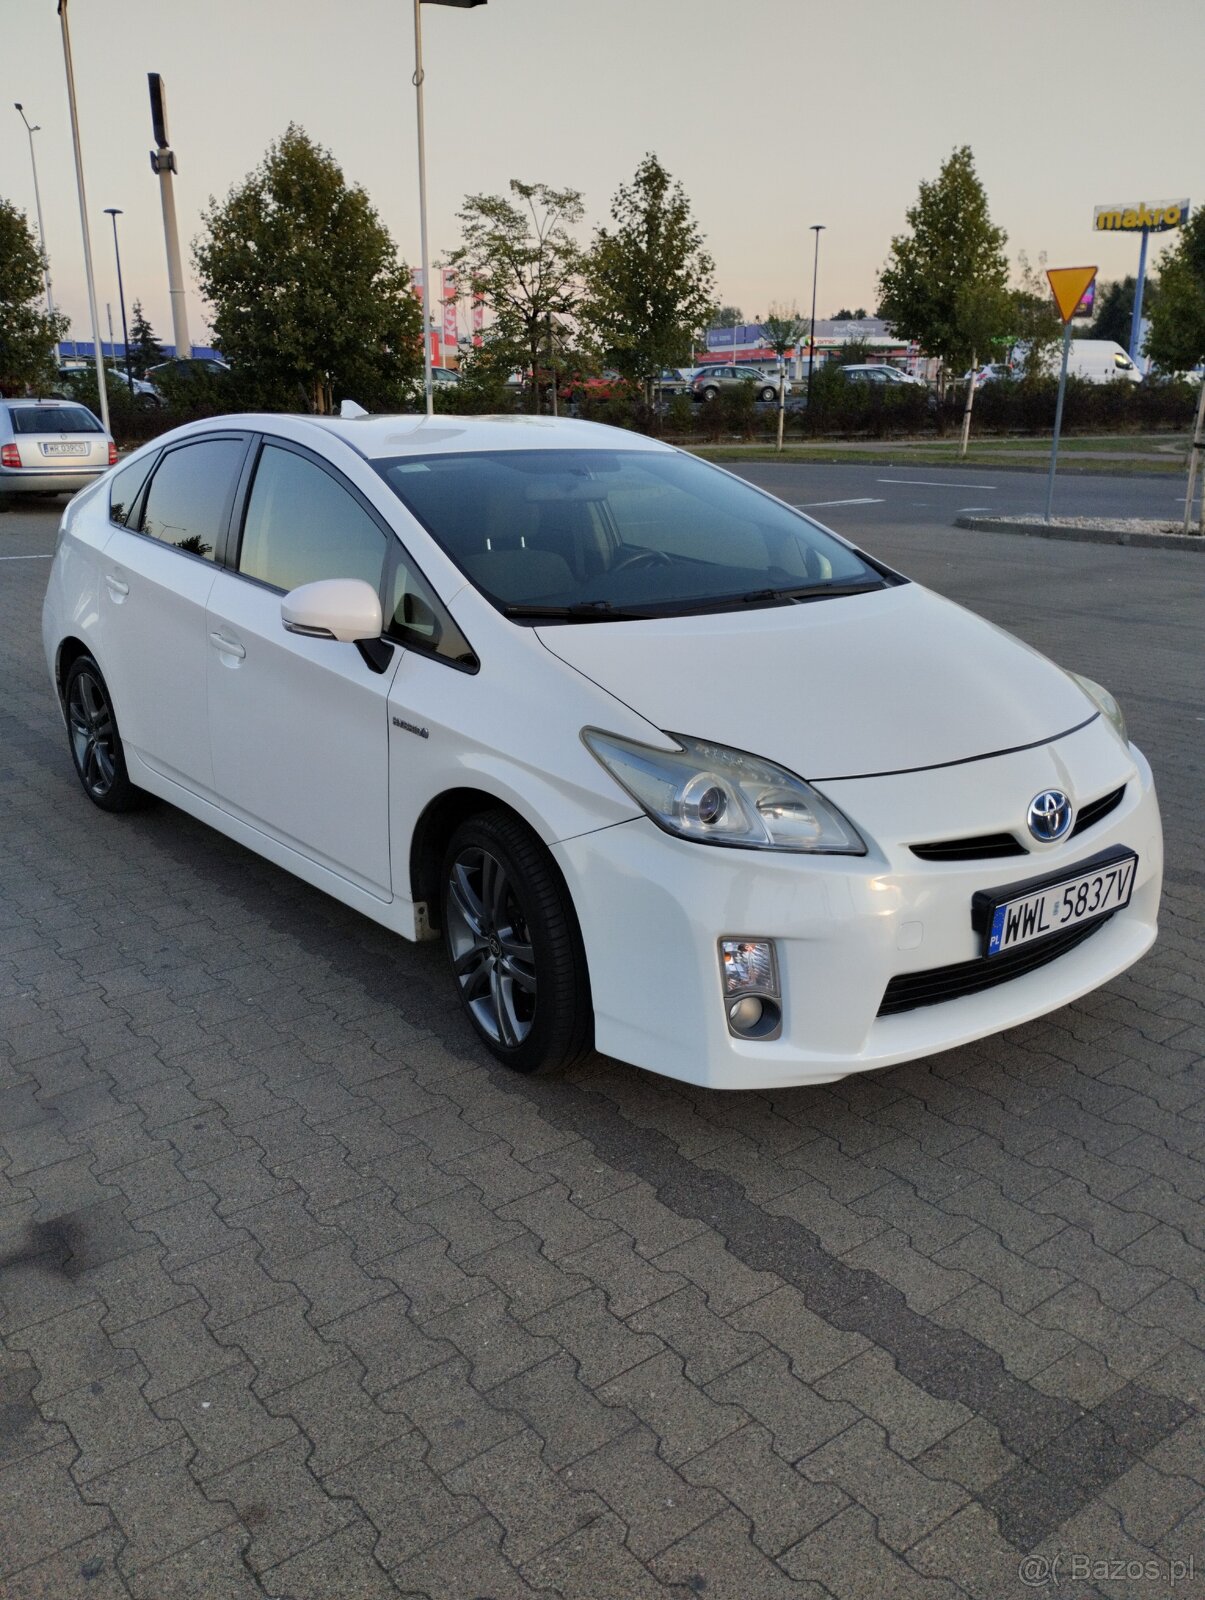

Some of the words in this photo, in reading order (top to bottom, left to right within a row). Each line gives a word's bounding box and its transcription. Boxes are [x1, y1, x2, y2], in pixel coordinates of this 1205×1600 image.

[1097, 202, 1181, 230] makro
[1005, 897, 1050, 945] WWL
[1061, 866, 1131, 923] 5837V
[990, 935, 1000, 947] PL
